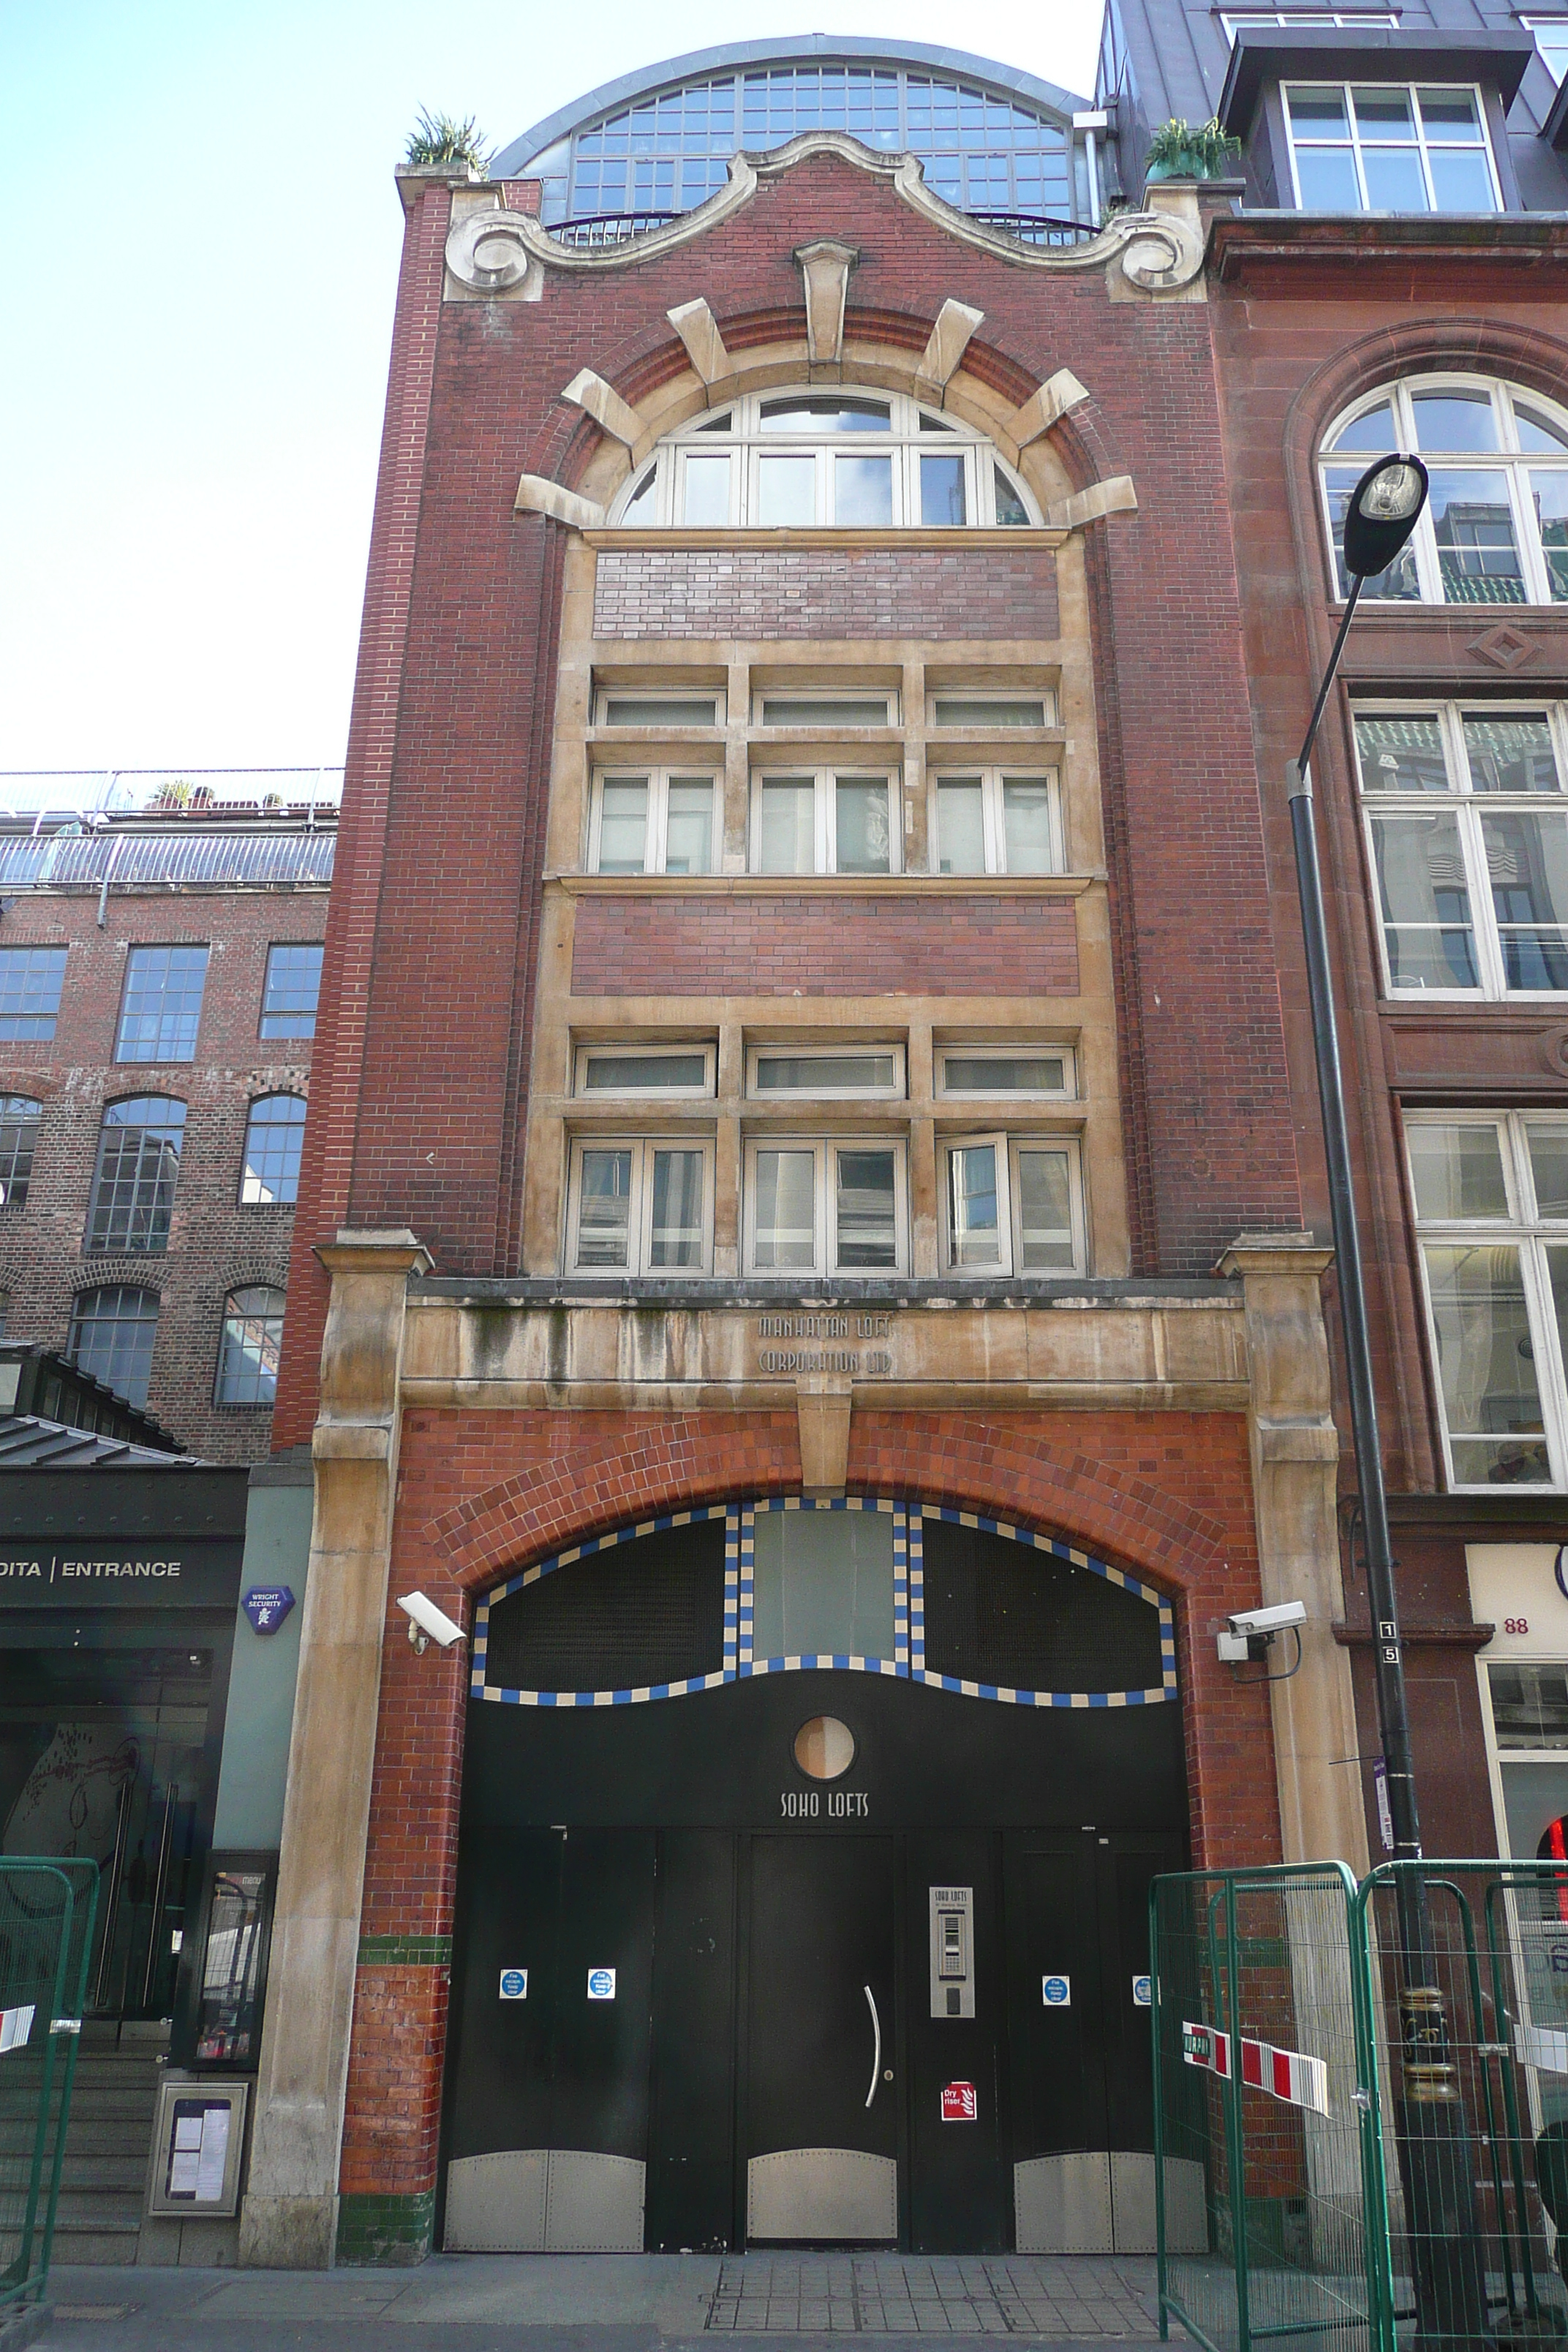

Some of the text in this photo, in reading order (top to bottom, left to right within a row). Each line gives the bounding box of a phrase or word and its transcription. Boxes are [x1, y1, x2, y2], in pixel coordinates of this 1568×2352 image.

[758, 1317, 889, 1338] MANHATTAN LOFT
[758, 1352, 891, 1372] CORPORATION LTD
[61, 1562, 181, 1577] ENTRANCE
[1384, 1624, 1392, 1635] 1
[1504, 1618, 1529, 1634] 88
[1386, 1648, 1395, 1660] 5
[781, 1793, 869, 1817] SOHO LOFTS
[935, 1891, 967, 1901] SOHO LOFTS
[944, 2089, 957, 2098] Dry
